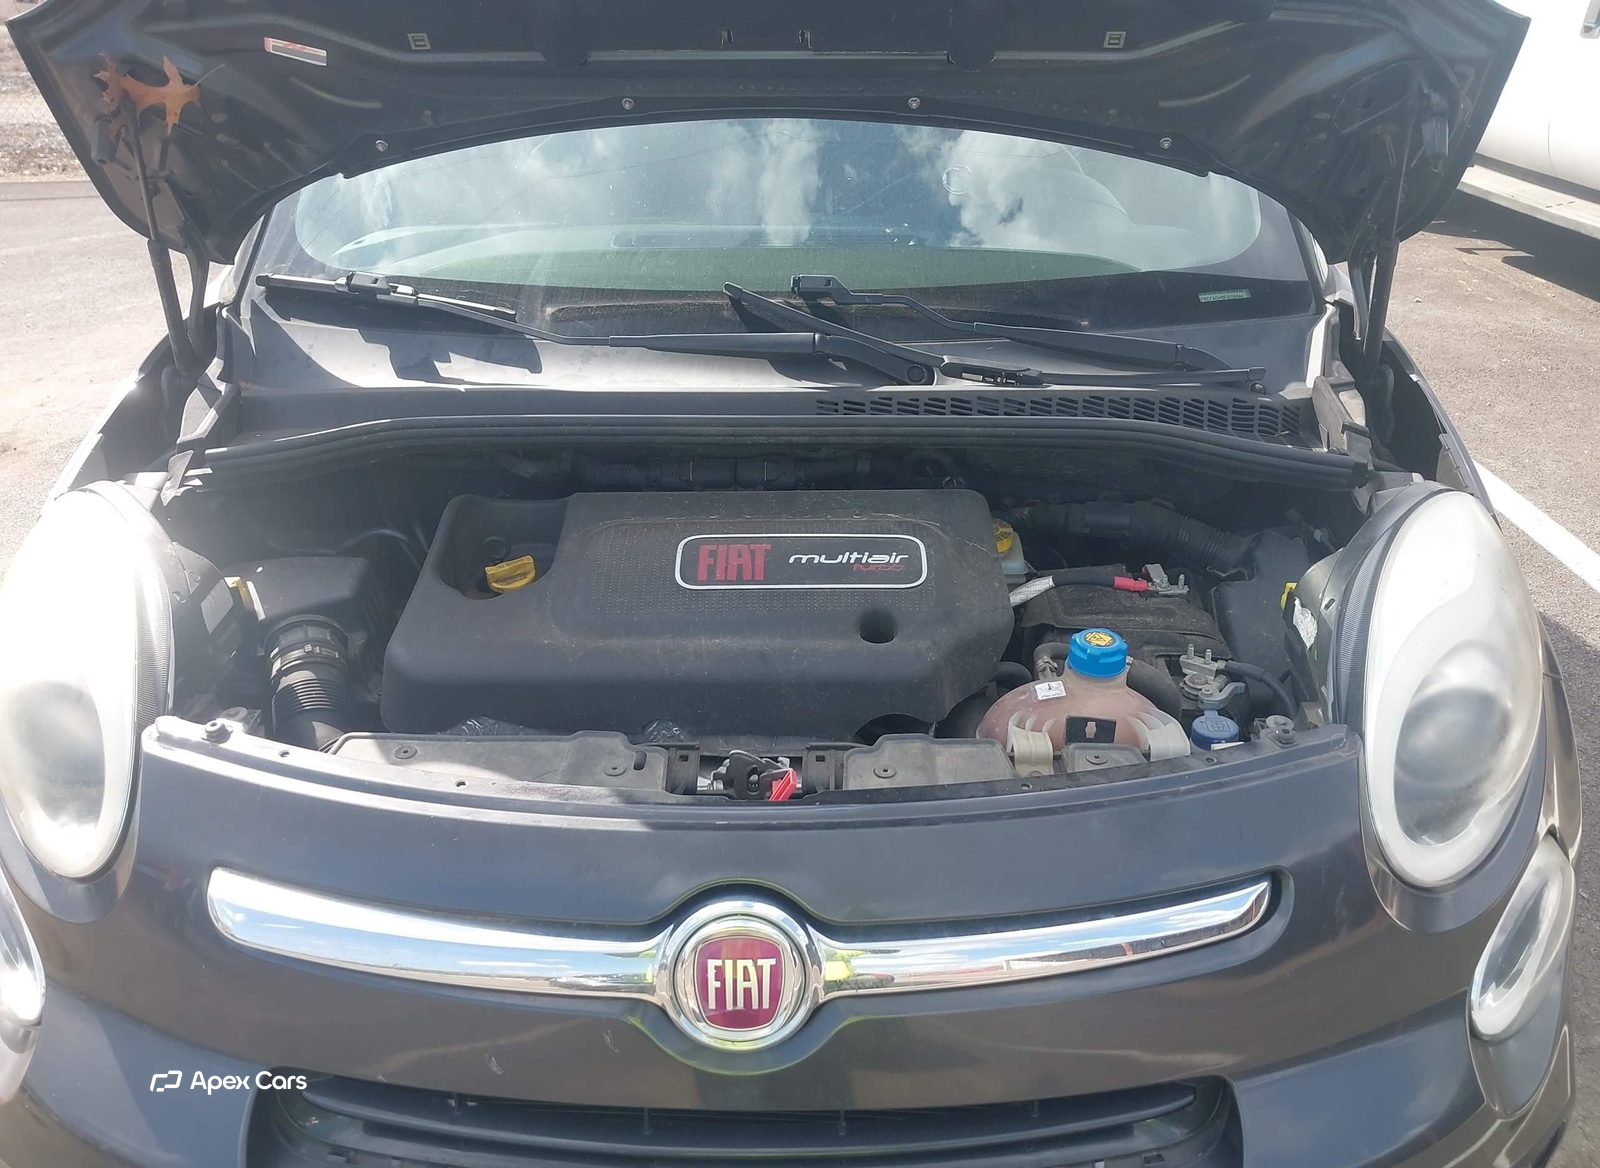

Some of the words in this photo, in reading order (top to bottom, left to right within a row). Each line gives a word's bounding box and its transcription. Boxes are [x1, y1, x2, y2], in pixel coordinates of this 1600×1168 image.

[697, 544, 772, 581] FIAT
[788, 551, 909, 564] multiair
[707, 958, 776, 1010] FIAT
